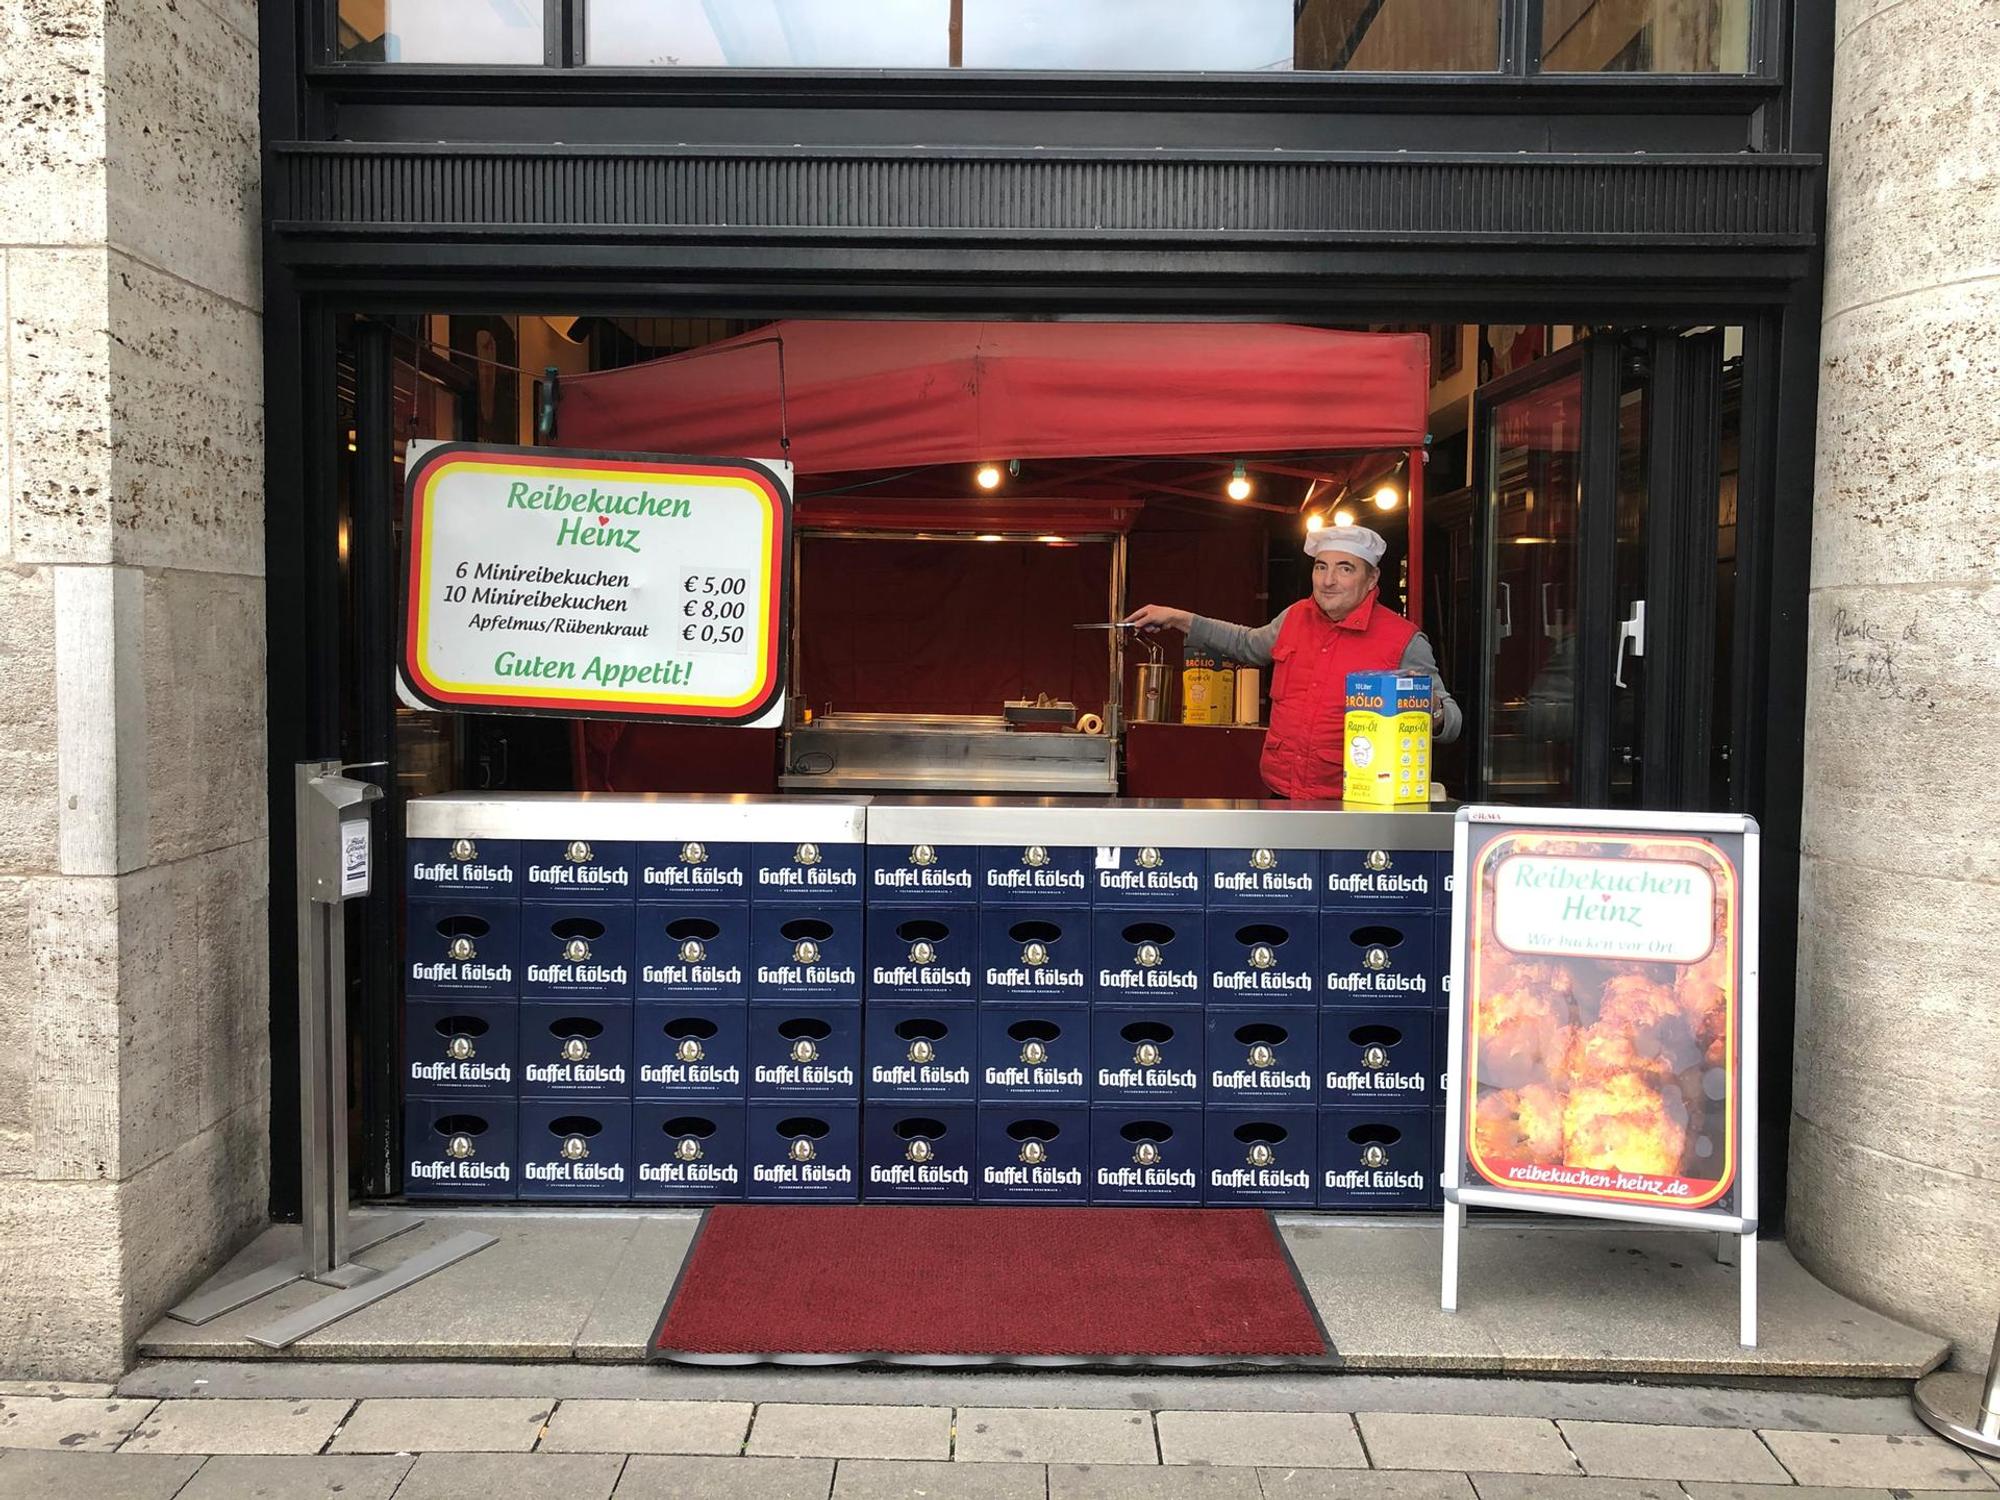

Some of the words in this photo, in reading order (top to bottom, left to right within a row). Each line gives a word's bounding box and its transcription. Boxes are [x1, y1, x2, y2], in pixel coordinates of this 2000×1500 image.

[507, 482, 692, 518] Reibekuchen
[556, 517, 641, 553] Heinz
[456, 562, 468, 579] 6
[474, 563, 630, 589] Minireibekuchen
[684, 575, 698, 592] €
[702, 576, 746, 596] 5,00
[443, 586, 466, 603] 10
[472, 587, 628, 613] Minireibekuchen
[683, 600, 697, 617] €
[701, 600, 745, 620] 8,00
[468, 613, 649, 639] Apfelmus/Rübenkraut
[682, 624, 696, 641] €
[701, 625, 744, 645] 0,50
[494, 651, 575, 680] Guten
[581, 655, 693, 688] Appetit!
[1397, 695, 1430, 708] BRÖLIO
[1347, 721, 1378, 733] Raps-Öl
[1399, 721, 1429, 734] Raps-Öl
[414, 863, 458, 881] Gaffel
[462, 865, 512, 883] Kölsch
[529, 865, 574, 884] Gaffel
[578, 866, 628, 886] Kölsch
[644, 867, 690, 885] Gaffel
[692, 868, 742, 886] Kölsch
[759, 868, 803, 885] Gaffel
[806, 868, 856, 885] Kölsch
[875, 868, 919, 887] Gaffel
[921, 869, 971, 888] Kölsch
[988, 869, 1032, 887] Gaffel
[1034, 870, 1084, 889] Kölsch
[1100, 871, 1145, 889] Gaffel
[1148, 872, 1198, 891] Kölsch
[1215, 872, 1259, 890] Gaffel
[1262, 873, 1312, 891] Kölsch
[1515, 863, 1692, 896] Reibekuchen
[1329, 874, 1374, 892] Gaffel
[1377, 875, 1427, 893] Kölsch
[1562, 895, 1644, 927] Heinz
[413, 963, 457, 980] Gaffel
[461, 965, 511, 982] Kölsch
[528, 965, 573, 983] Gaffel
[576, 966, 626, 984] Kölsch
[643, 966, 688, 984] Gaffel
[691, 966, 741, 984] Kölsch
[758, 967, 802, 984] Gaffel
[805, 967, 855, 984] Kölsch
[874, 967, 918, 985] Gaffel
[920, 967, 970, 986] Kölsch
[987, 968, 1031, 986] Gaffel
[1033, 969, 1083, 987] Kölsch
[1100, 970, 1144, 988] Gaffel
[1147, 970, 1197, 990] Kölsch
[1213, 971, 1257, 989] Gaffel
[1261, 972, 1311, 991] Kölsch
[1328, 973, 1372, 991] Gaffel
[1375, 974, 1425, 992] Kölsch
[412, 1062, 456, 1080] Gaffel
[460, 1063, 510, 1082] Kölsch
[526, 1064, 571, 1082] Gaffel
[575, 1064, 625, 1084] Kölsch
[641, 1065, 685, 1083] Gaffel
[689, 1065, 739, 1084] Kölsch
[755, 1065, 800, 1084] Gaffel
[803, 1066, 853, 1085] Kölsch
[873, 1066, 917, 1084] Gaffel
[919, 1067, 969, 1084] Kölsch
[986, 1067, 1030, 1085] Gaffel
[1032, 1068, 1082, 1086] Kölsch
[1099, 1069, 1144, 1087] Gaffel
[1146, 1069, 1196, 1088] Kölsch
[1213, 1071, 1257, 1089] Gaffel
[1260, 1071, 1310, 1090] Kölsch
[1327, 1072, 1371, 1090] Gaffel
[1374, 1072, 1424, 1091] Kölsch
[412, 1161, 456, 1179] Gaffel
[459, 1162, 509, 1181] Kölsch
[526, 1162, 571, 1181] Gaffel
[574, 1163, 624, 1182] Kölsch
[640, 1163, 685, 1182] Gaffel
[687, 1164, 737, 1183] Kölsch
[754, 1165, 798, 1182] Gaffel
[801, 1165, 851, 1182] Kölsch
[871, 1165, 915, 1183] Gaffel
[918, 1166, 968, 1185] Kölsch
[985, 1167, 1029, 1184] Gaffel
[1031, 1168, 1081, 1185] Kölsch
[1098, 1168, 1143, 1186] Gaffel
[1145, 1168, 1195, 1188] Kölsch
[1212, 1169, 1257, 1187] Gaffel
[1259, 1170, 1309, 1189] Kölsch
[1326, 1170, 1370, 1189] Gaffel
[1373, 1171, 1423, 1190] Kölsch
[1508, 1163, 1689, 1197] reibekuchen-heinz.de
